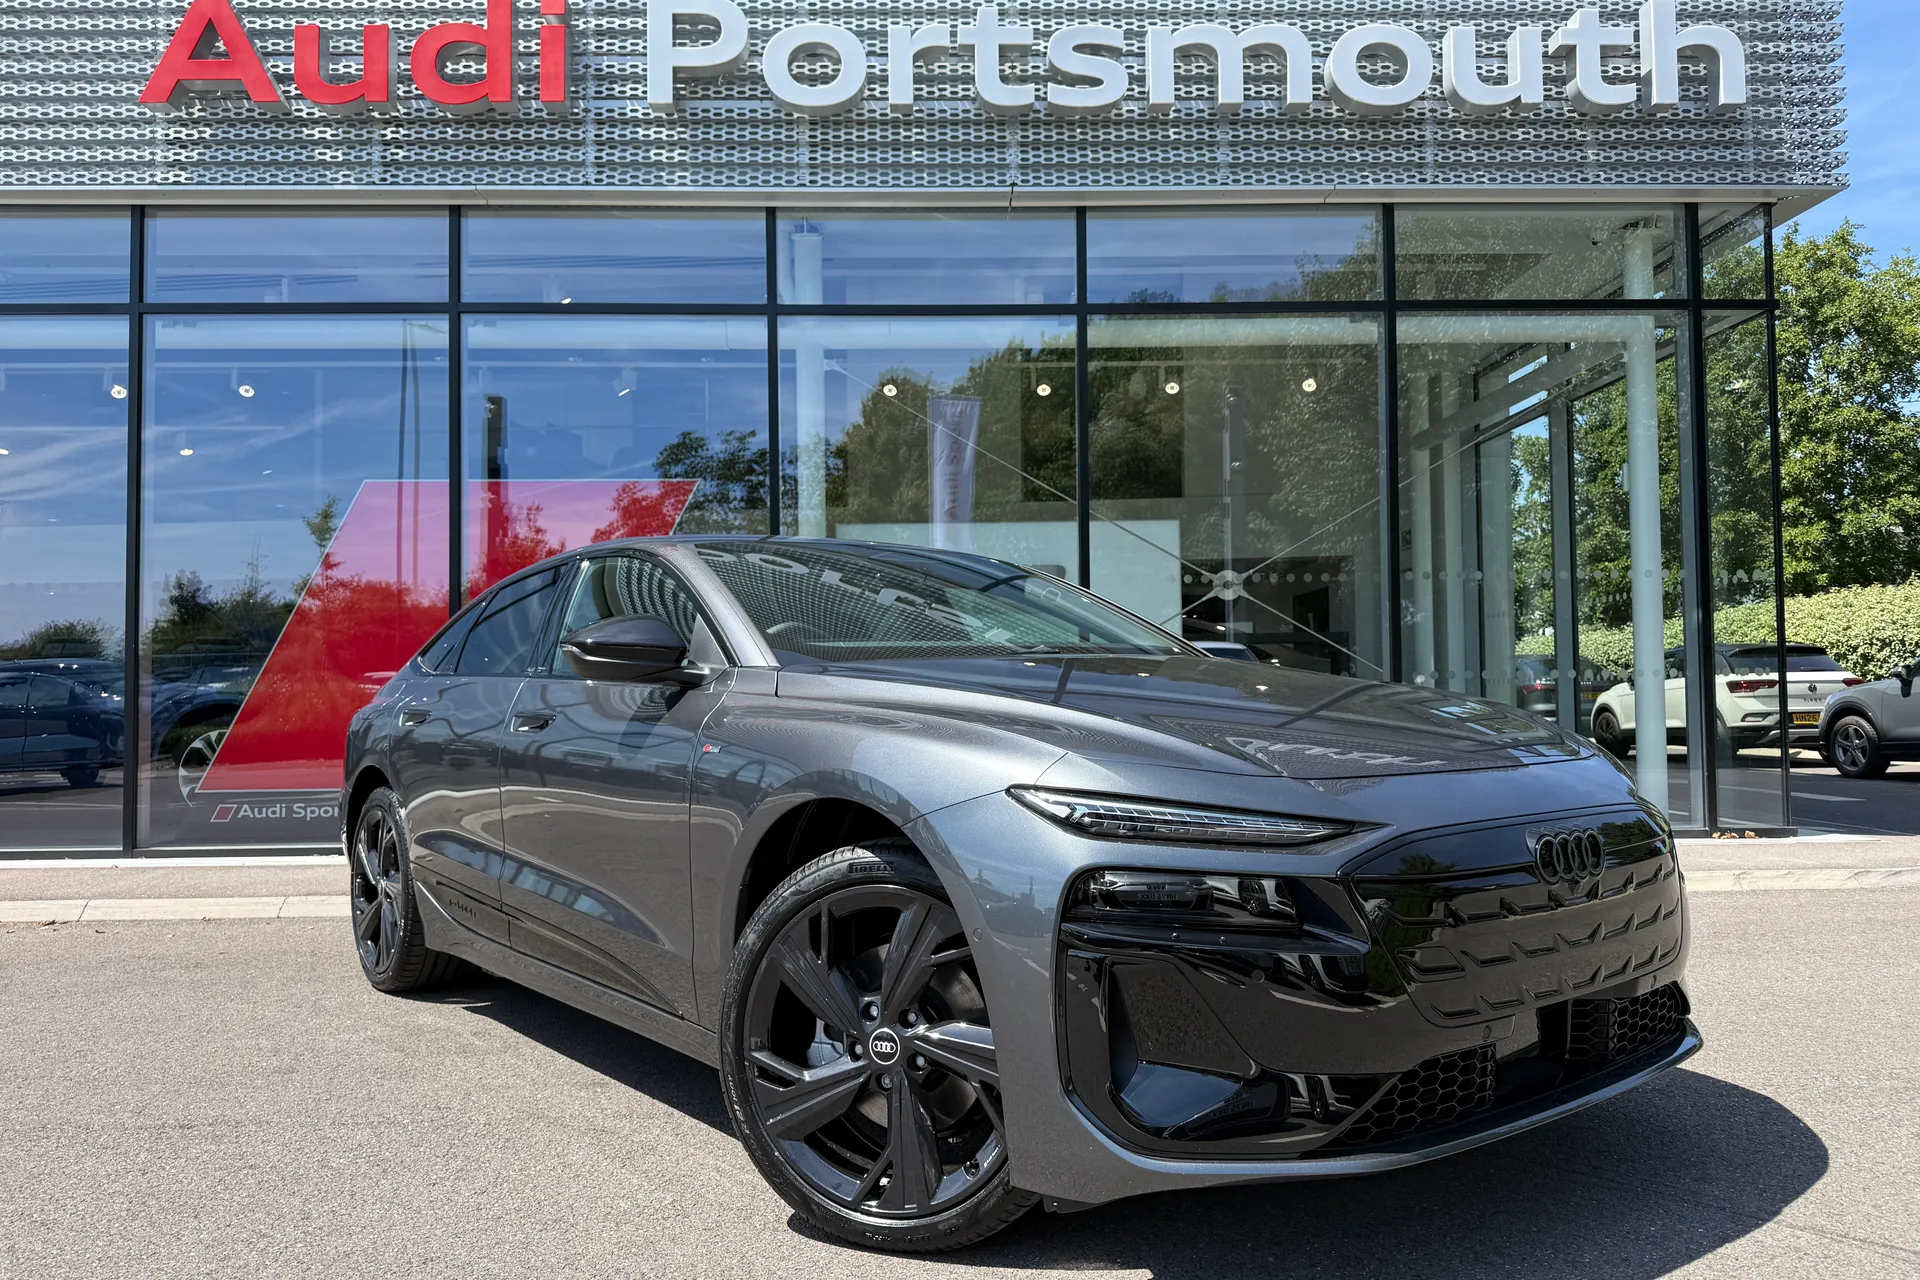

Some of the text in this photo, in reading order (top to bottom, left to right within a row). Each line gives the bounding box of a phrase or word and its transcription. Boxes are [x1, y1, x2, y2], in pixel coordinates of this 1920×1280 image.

[138, 0, 1747, 110] Audi Portsmouth
[1795, 714, 1818, 722] HN25
[237, 803, 339, 820] Audi Spor
